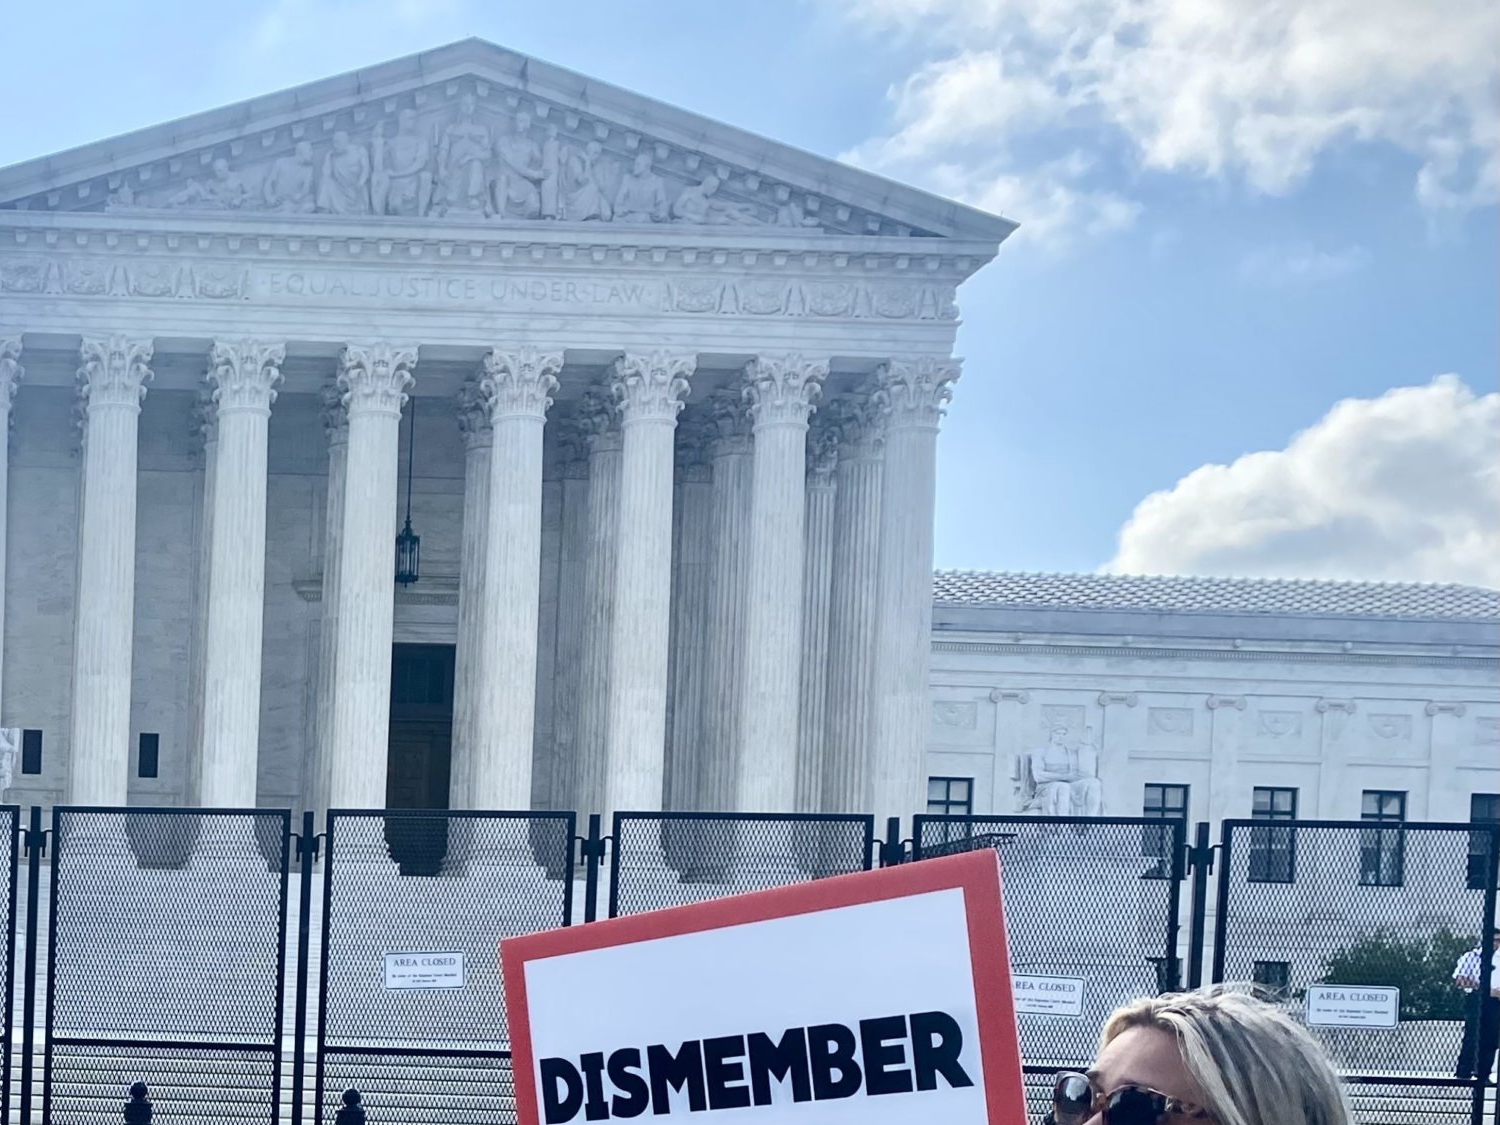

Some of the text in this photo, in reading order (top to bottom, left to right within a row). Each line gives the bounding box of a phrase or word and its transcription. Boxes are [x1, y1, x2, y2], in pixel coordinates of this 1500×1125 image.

[270, 273, 645, 304] EQUAL JUSTICE UNDER LAW
[393, 957, 456, 967] AREA CLOSED
[1015, 980, 1076, 993] REA CLOSED
[1318, 992, 1388, 1002] AREA CLOSED
[539, 1010, 974, 1125] DISMEMBER
